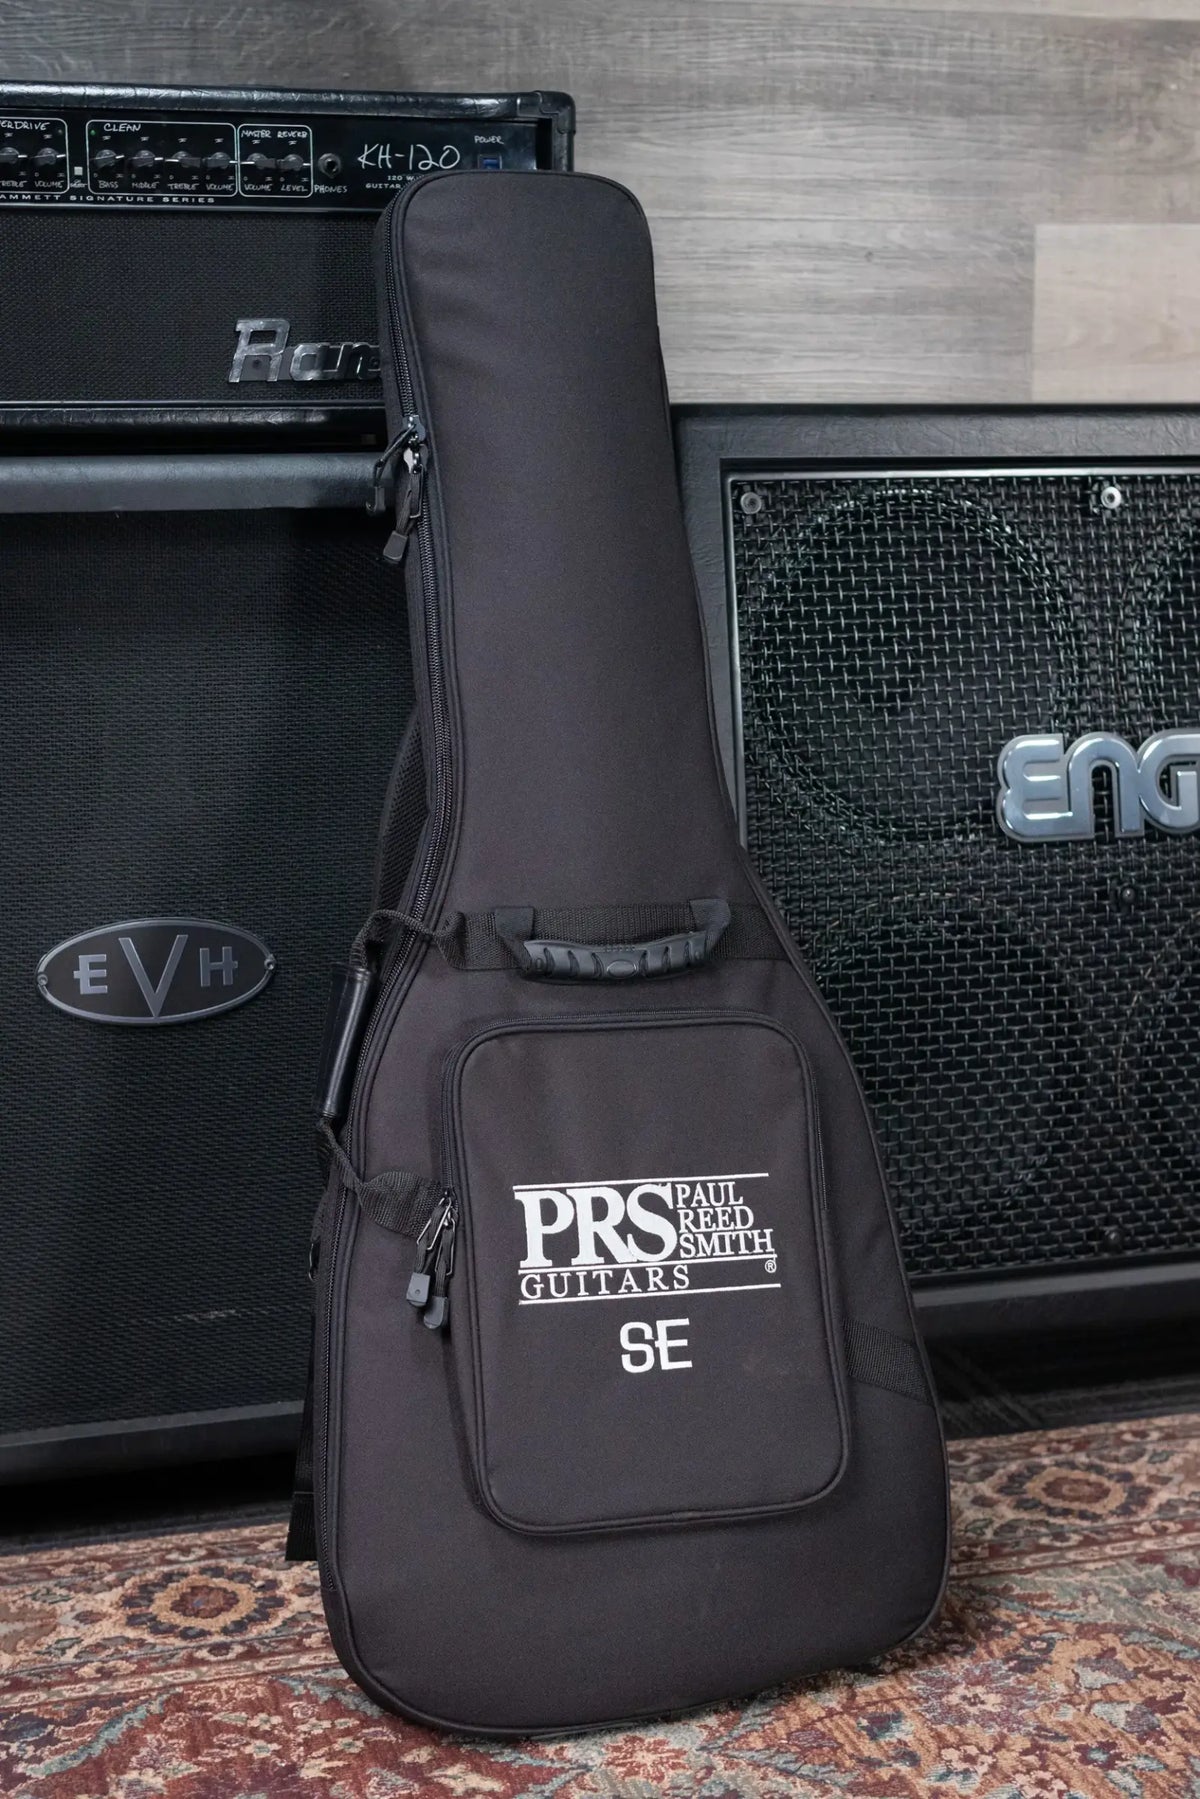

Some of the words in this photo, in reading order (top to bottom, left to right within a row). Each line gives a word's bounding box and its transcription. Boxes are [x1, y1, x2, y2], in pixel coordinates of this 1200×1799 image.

[0, 120, 50, 130] ERDRIVE
[103, 123, 141, 132] CLEAN
[241, 130, 272, 138] MASTER
[474, 135, 504, 144] POWER
[357, 143, 460, 170] KH-120
[34, 180, 64, 188] VOLUME
[98, 180, 119, 188] BASS
[131, 181, 160, 189] MIDDLE
[167, 182, 199, 190] TREBLE
[206, 183, 235, 191] VOLUME
[244, 183, 273, 191] VOLUME
[314, 184, 348, 193] PHONES
[73, 934, 238, 1018] EVH
[675, 1181, 744, 1208] PAUL
[677, 1205, 755, 1233] REED
[514, 1183, 678, 1268] PRS
[679, 1228, 776, 1260] SMITH
[520, 1265, 690, 1300] GUITARS
[619, 1317, 693, 1374] SE
